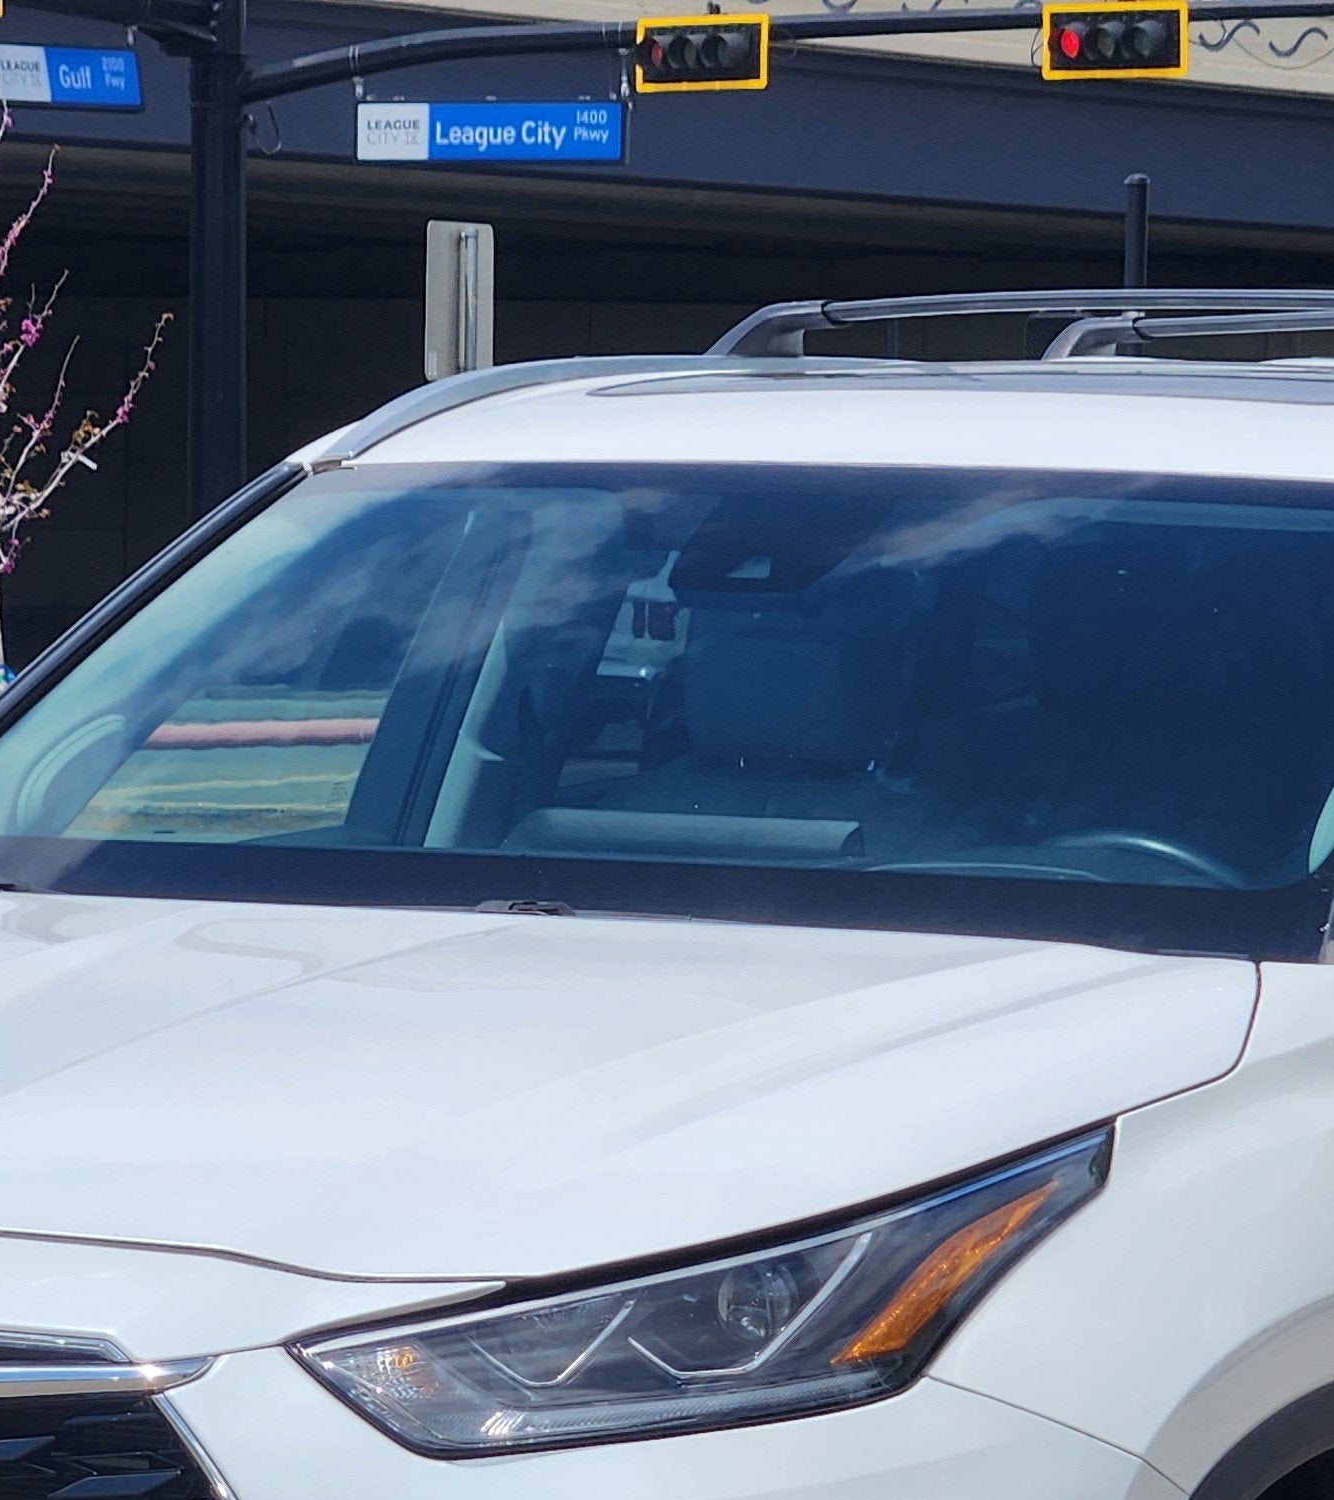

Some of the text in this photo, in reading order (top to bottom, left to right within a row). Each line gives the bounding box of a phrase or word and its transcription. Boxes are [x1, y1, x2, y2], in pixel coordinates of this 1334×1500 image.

[0, 60, 41, 72] LEAGUE
[58, 63, 93, 90] Gulf
[367, 118, 420, 131] LEAGUE
[576, 109, 608, 125] 1400
[367, 132, 398, 146] CITY
[435, 120, 567, 152] League City
[573, 126, 610, 144] Pkwy
